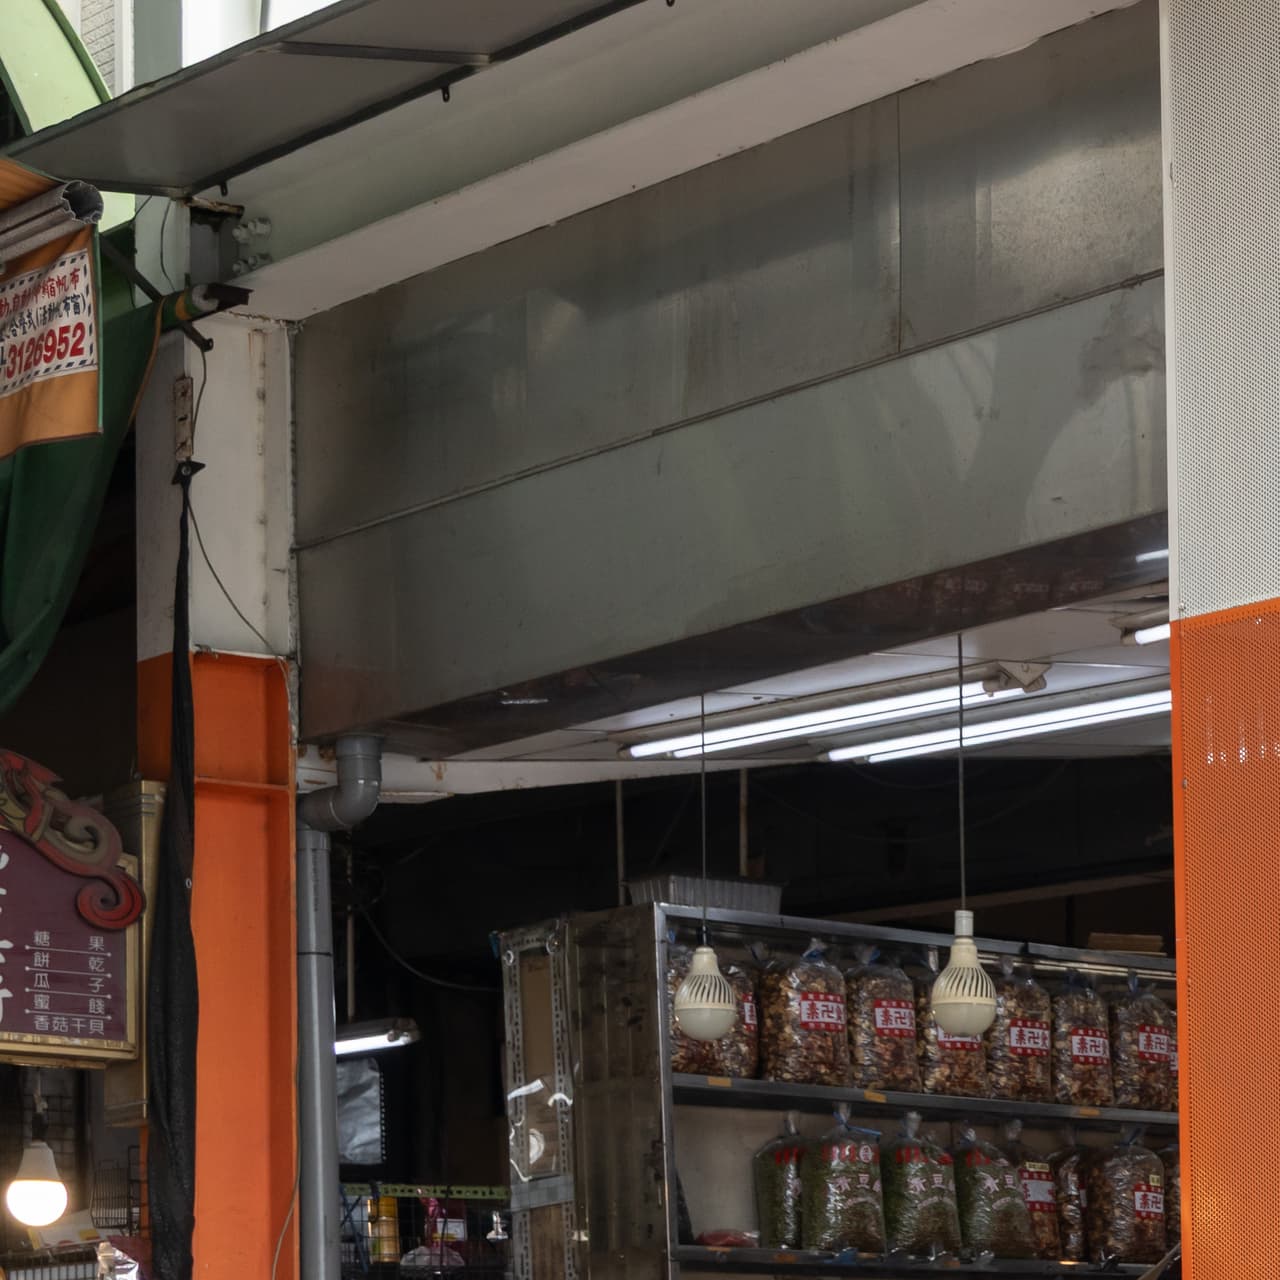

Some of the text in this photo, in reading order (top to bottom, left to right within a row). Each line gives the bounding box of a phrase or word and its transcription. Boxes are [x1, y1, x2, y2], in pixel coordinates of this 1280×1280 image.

[6, 322, 86, 379] 3126952
[33, 1015, 105, 1035] 香菇干貝
